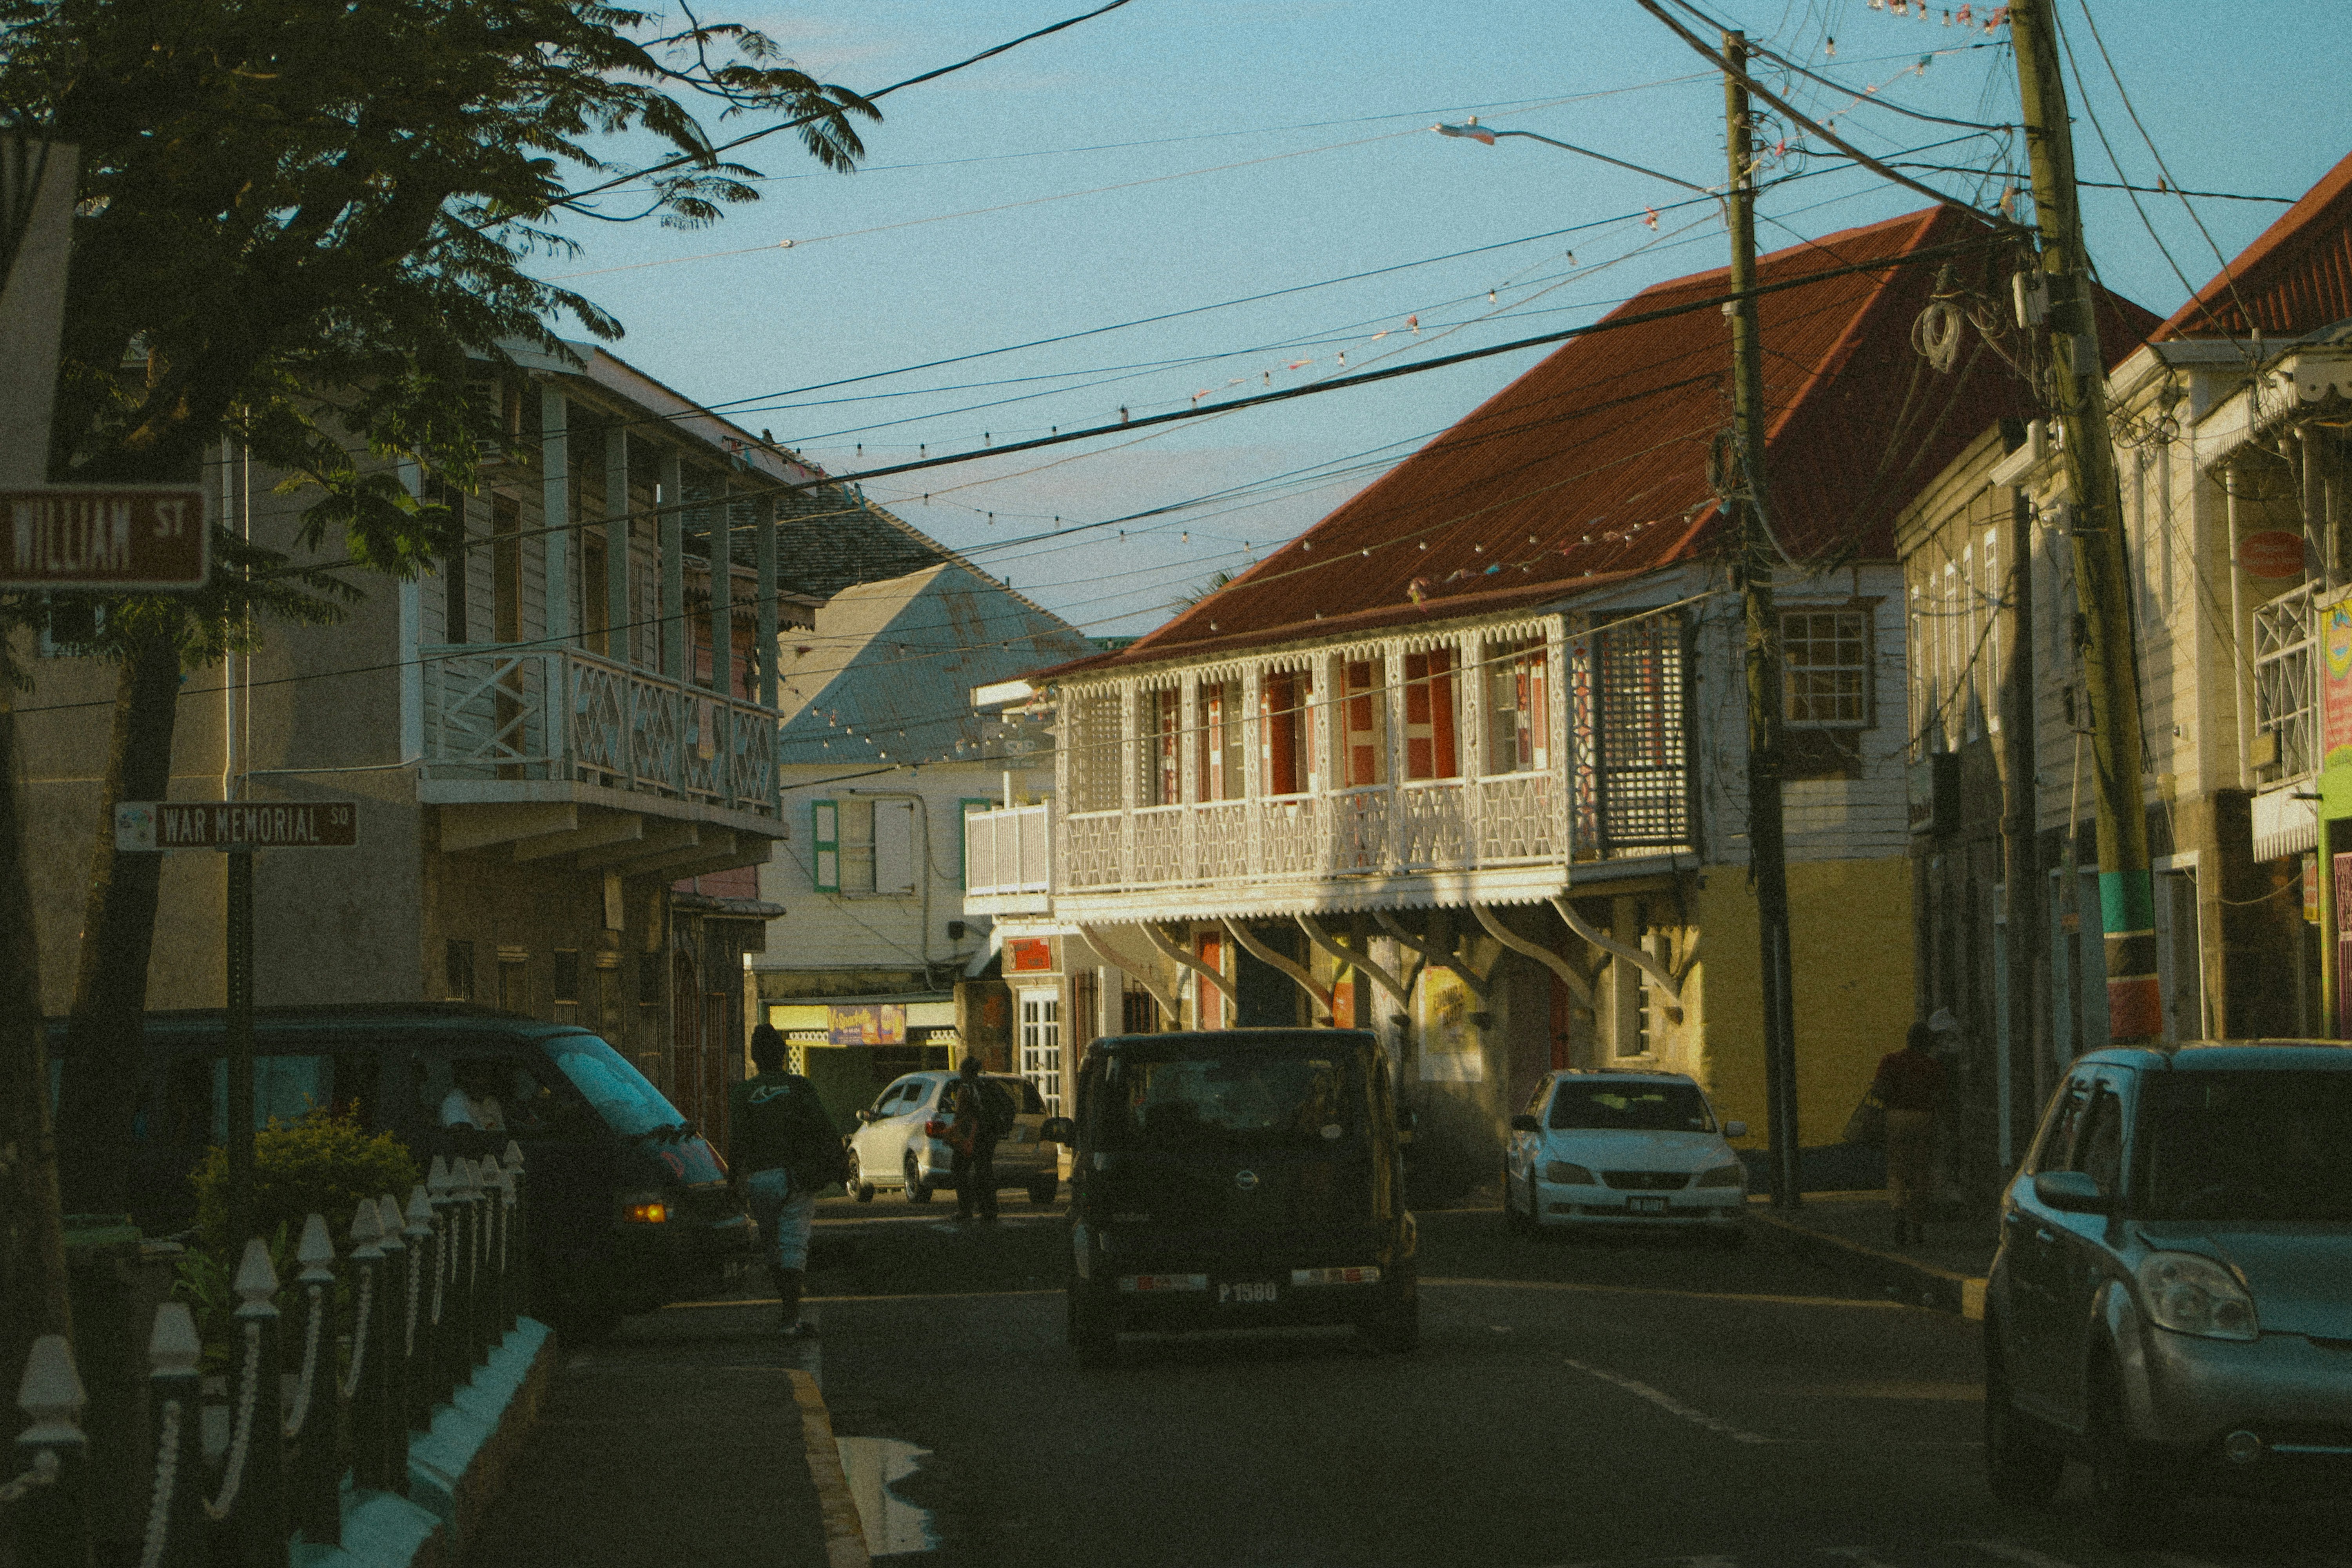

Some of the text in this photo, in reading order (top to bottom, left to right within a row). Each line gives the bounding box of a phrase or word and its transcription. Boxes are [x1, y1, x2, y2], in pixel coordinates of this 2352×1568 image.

[11, 499, 186, 571] WILLIAM ST
[163, 807, 348, 842] WAR MEMORIAL SQ
[1219, 1282, 1276, 1302] P 1580
